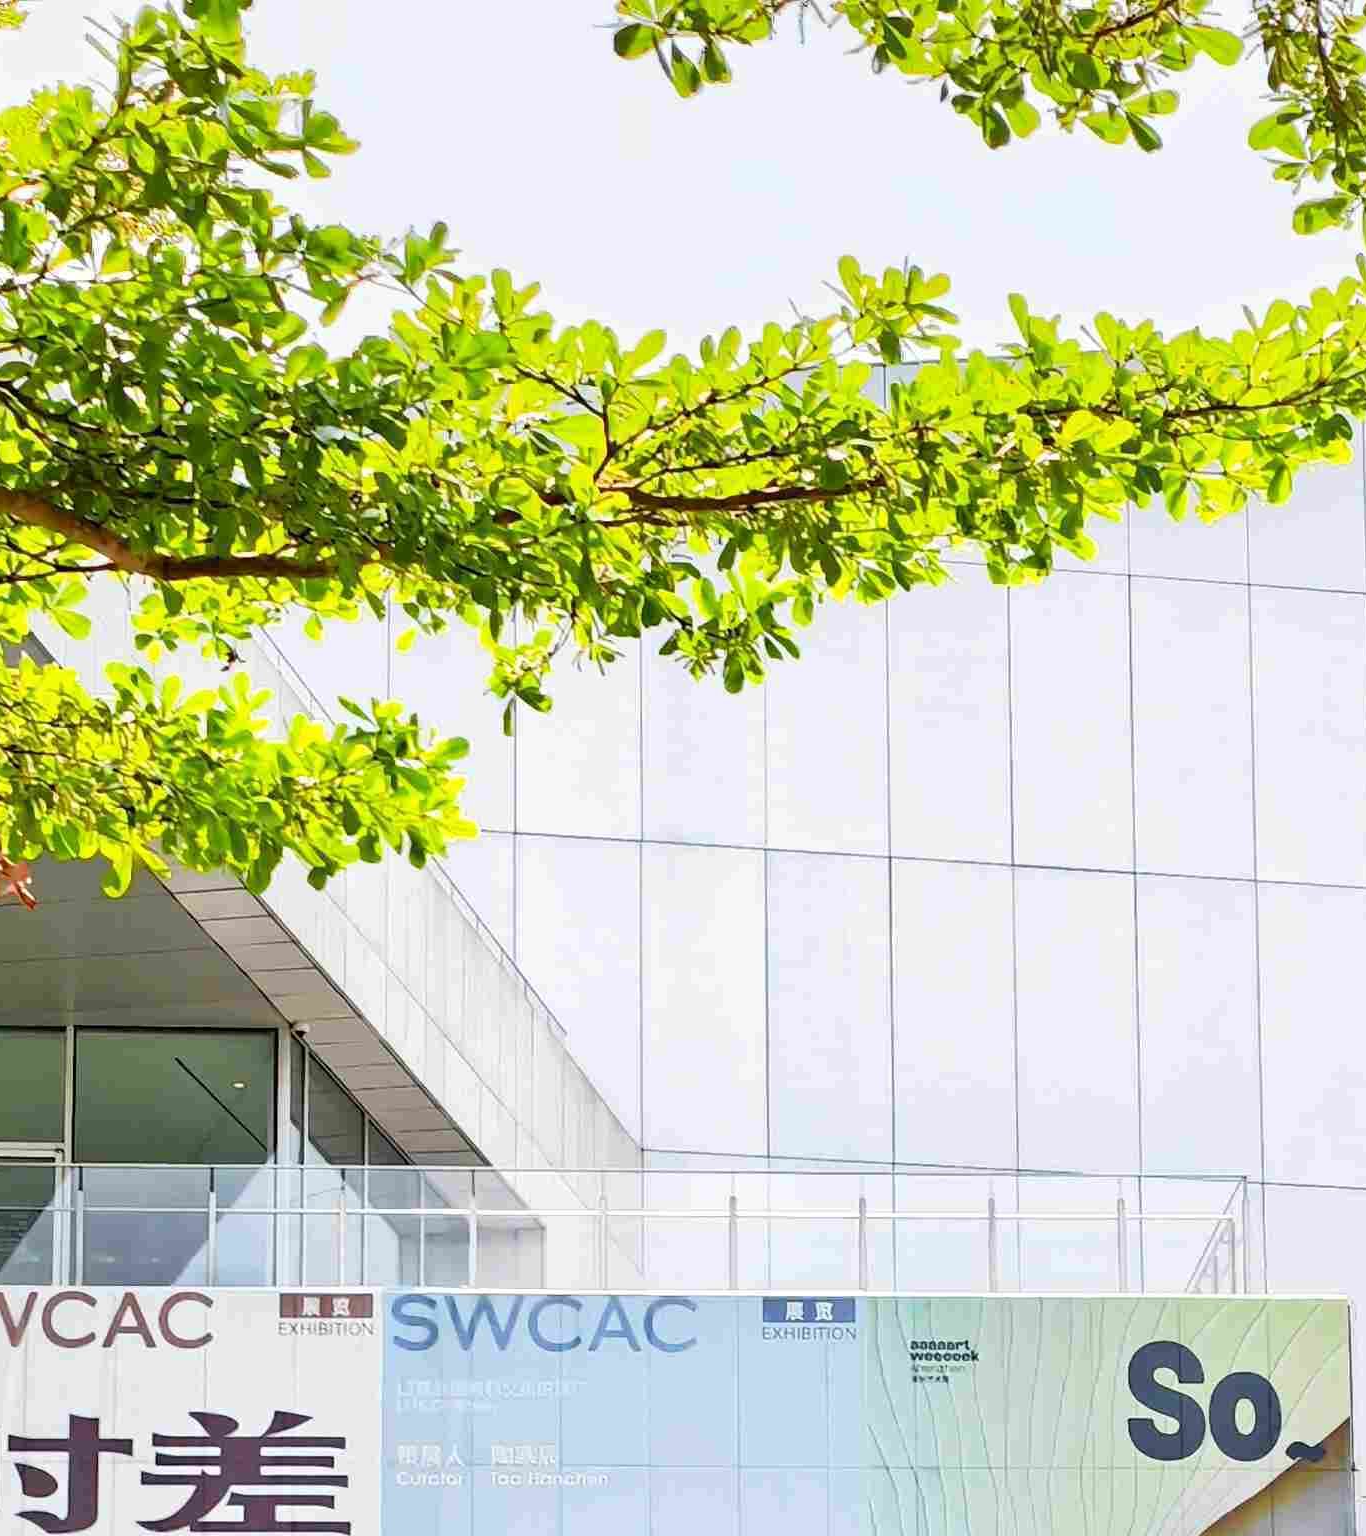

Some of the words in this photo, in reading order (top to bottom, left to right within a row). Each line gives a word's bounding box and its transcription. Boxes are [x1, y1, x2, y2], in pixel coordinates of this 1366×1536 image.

[278, 1321, 375, 1336] EXHIBITION
[390, 1294, 698, 1352] SWCAC
[762, 1327, 857, 1341] EXHIBITION
